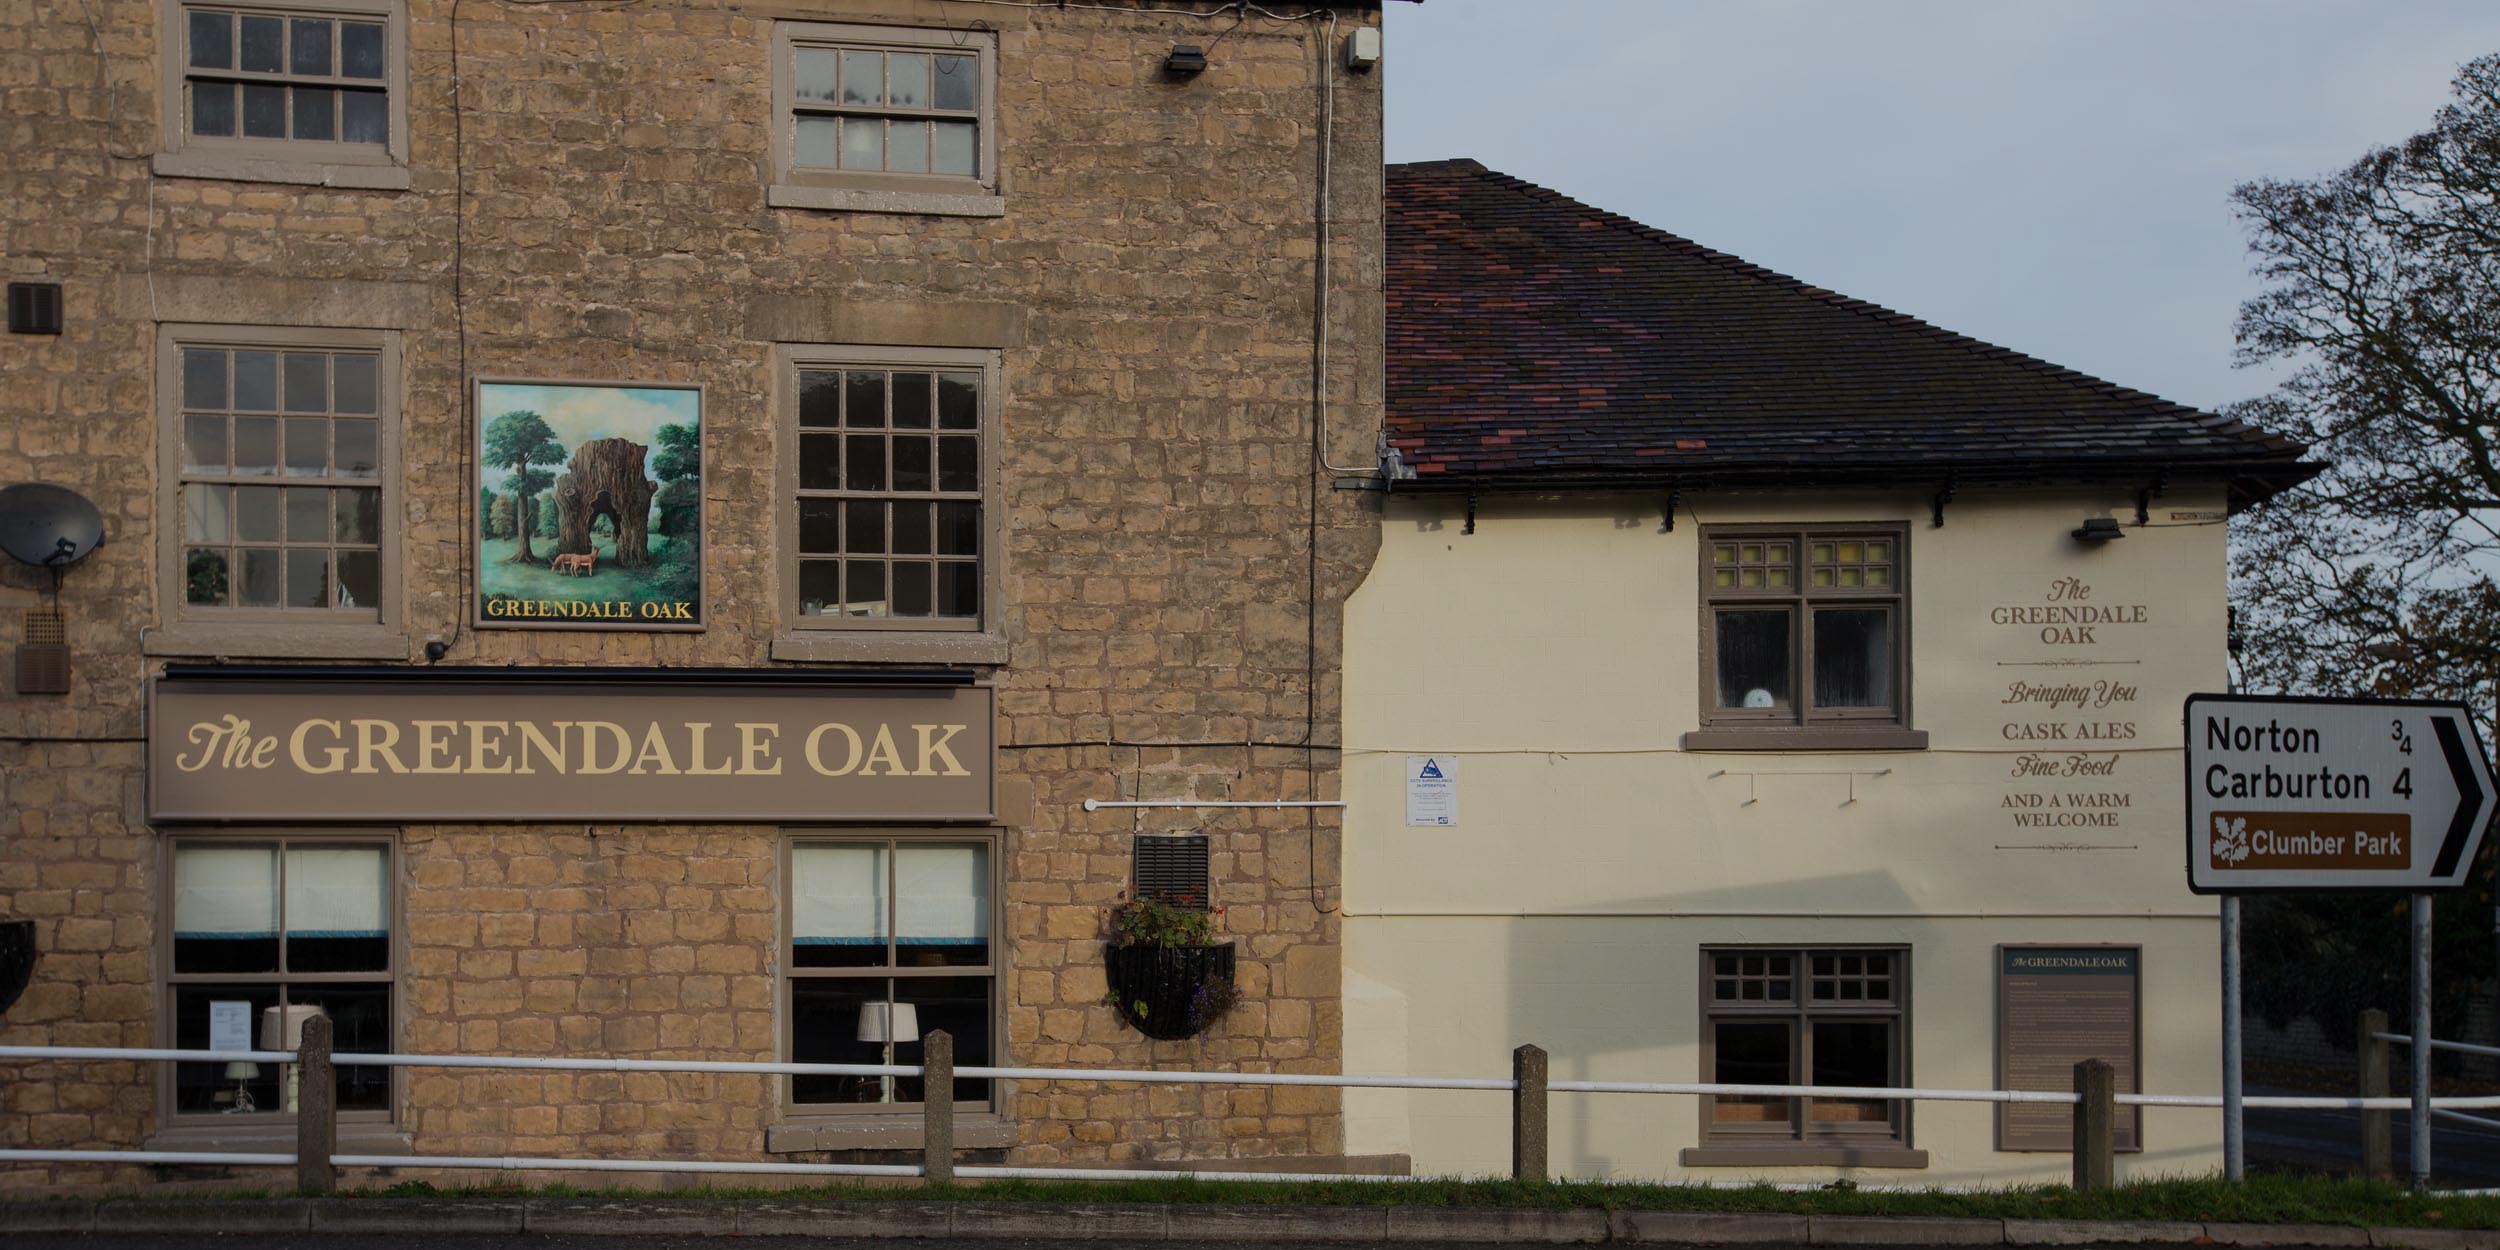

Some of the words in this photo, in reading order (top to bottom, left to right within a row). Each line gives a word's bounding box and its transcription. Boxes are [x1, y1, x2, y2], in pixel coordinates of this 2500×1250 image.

[2046, 576, 2091, 602] The
[486, 599, 633, 618] GREENDALE
[641, 601, 693, 619] OAK
[1990, 605, 2148, 625] GREENDALE
[2040, 626, 2097, 645] OAK
[2001, 680, 2091, 709] Bringing
[2093, 679, 2138, 709] You
[2002, 722, 2068, 741] CASK
[2075, 722, 2137, 740] ALES
[2207, 716, 2320, 754] Norton
[176, 713, 279, 772] The
[289, 718, 782, 776] GREENDALE
[804, 722, 972, 777] OAK
[2011, 753, 2060, 778] Fine
[2061, 752, 2120, 778] Food
[2205, 763, 2370, 800] Carburton
[2392, 767, 2413, 801] 4
[2001, 794, 2043, 808] AND
[2049, 794, 2061, 808] A
[2067, 793, 2131, 808] WARM
[2013, 812, 2119, 827] WELCOME
[2251, 829, 2346, 855] Clumber
[2354, 830, 2402, 856] Park
[2012, 956, 2027, 968] The
[2027, 957, 2100, 968] GREENDALE
[2101, 957, 2128, 968] OAK
